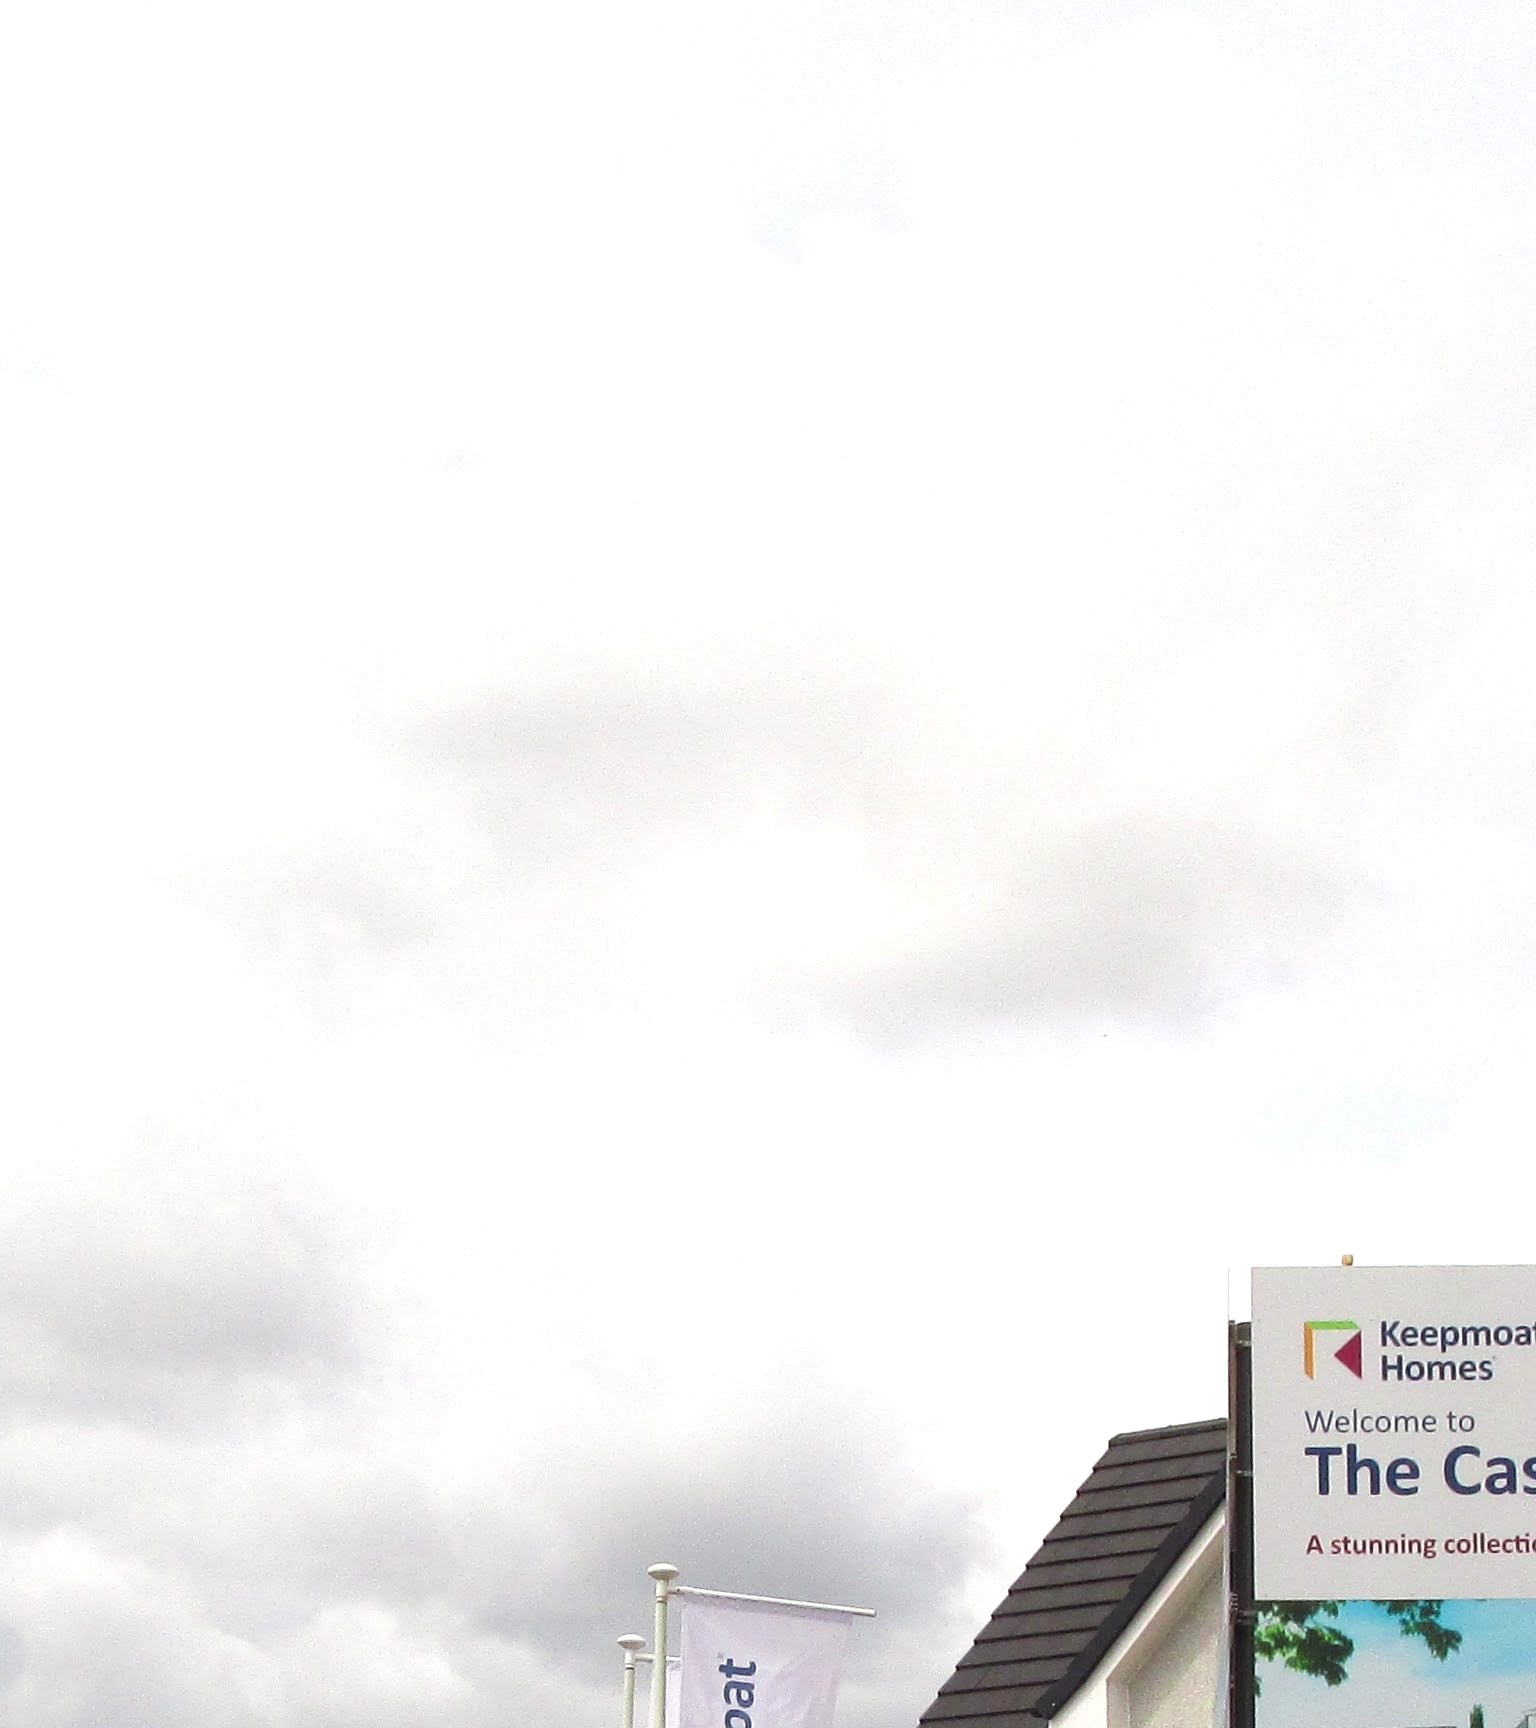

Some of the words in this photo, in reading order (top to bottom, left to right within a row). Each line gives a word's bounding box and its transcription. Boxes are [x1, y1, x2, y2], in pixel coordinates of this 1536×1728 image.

[1380, 1355, 1493, 1381] Homes
[1305, 1410, 1437, 1433] Welcome
[1447, 1411, 1475, 1433] to
[1305, 1444, 1420, 1495] The
[1306, 1535, 1323, 1555] A
[1330, 1535, 1436, 1558] stunning
